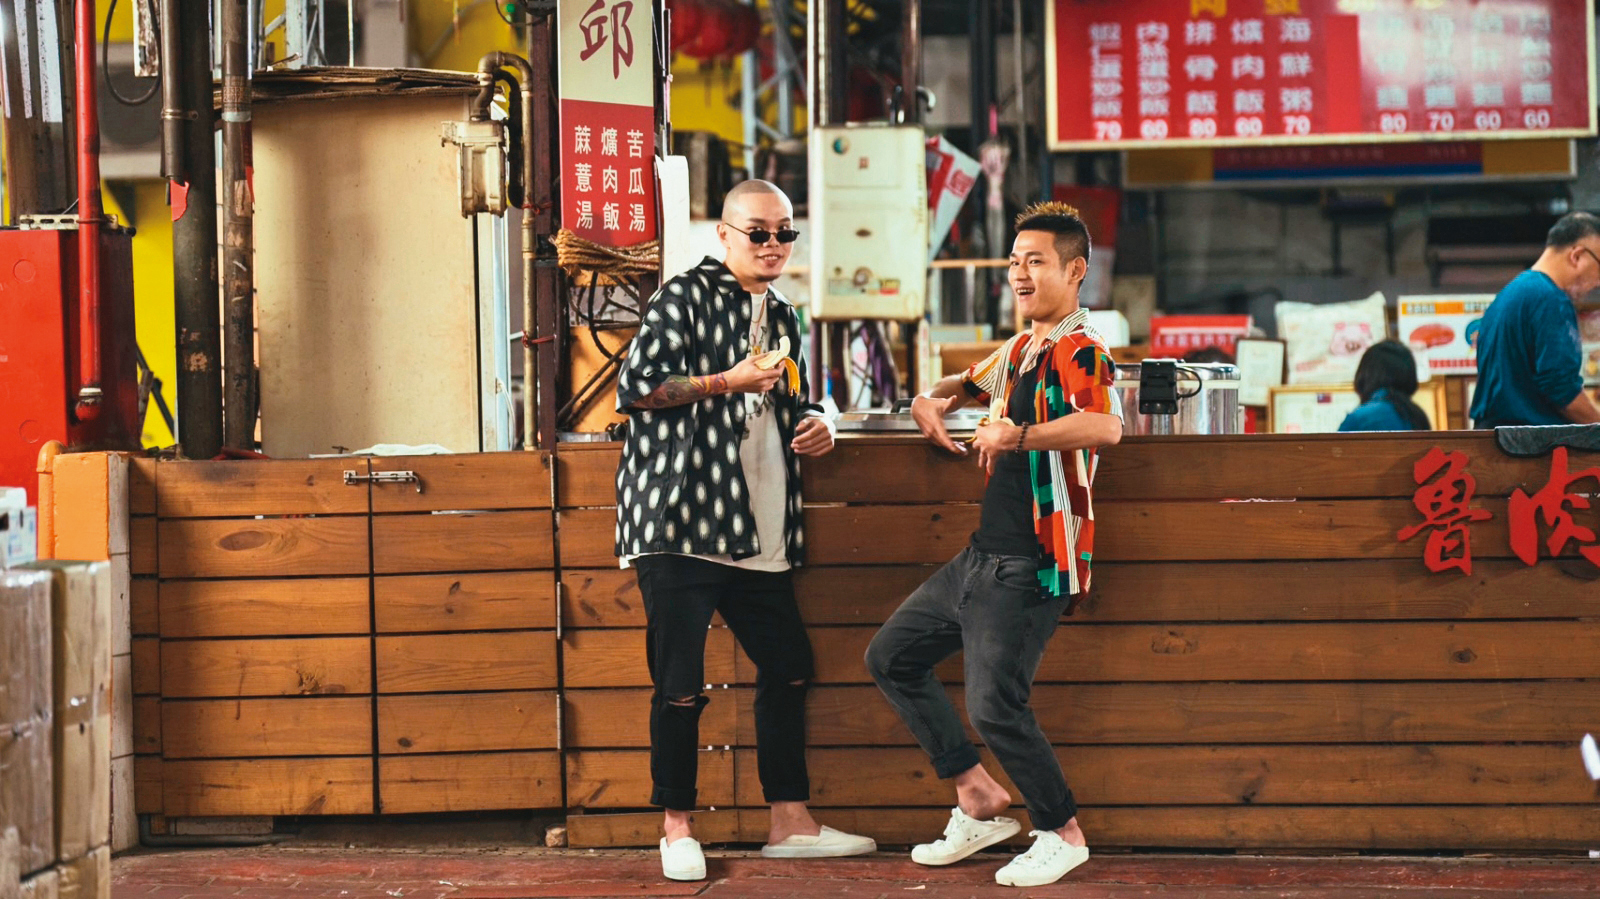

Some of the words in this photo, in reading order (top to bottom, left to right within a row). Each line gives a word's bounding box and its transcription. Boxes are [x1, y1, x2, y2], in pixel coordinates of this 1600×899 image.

[579, 0, 634, 80] 邱
[1185, 20, 1218, 114] 排骨飯
[1140, 119, 1168, 139] 60
[1189, 118, 1217, 138] 80
[1235, 117, 1263, 138] 60
[1284, 115, 1311, 135] 70
[1429, 110, 1454, 131] 70
[1475, 110, 1501, 130] 60
[1524, 109, 1550, 129] 60
[1094, 120, 1122, 140] 70
[627, 129, 646, 232] 苦瓜湯
